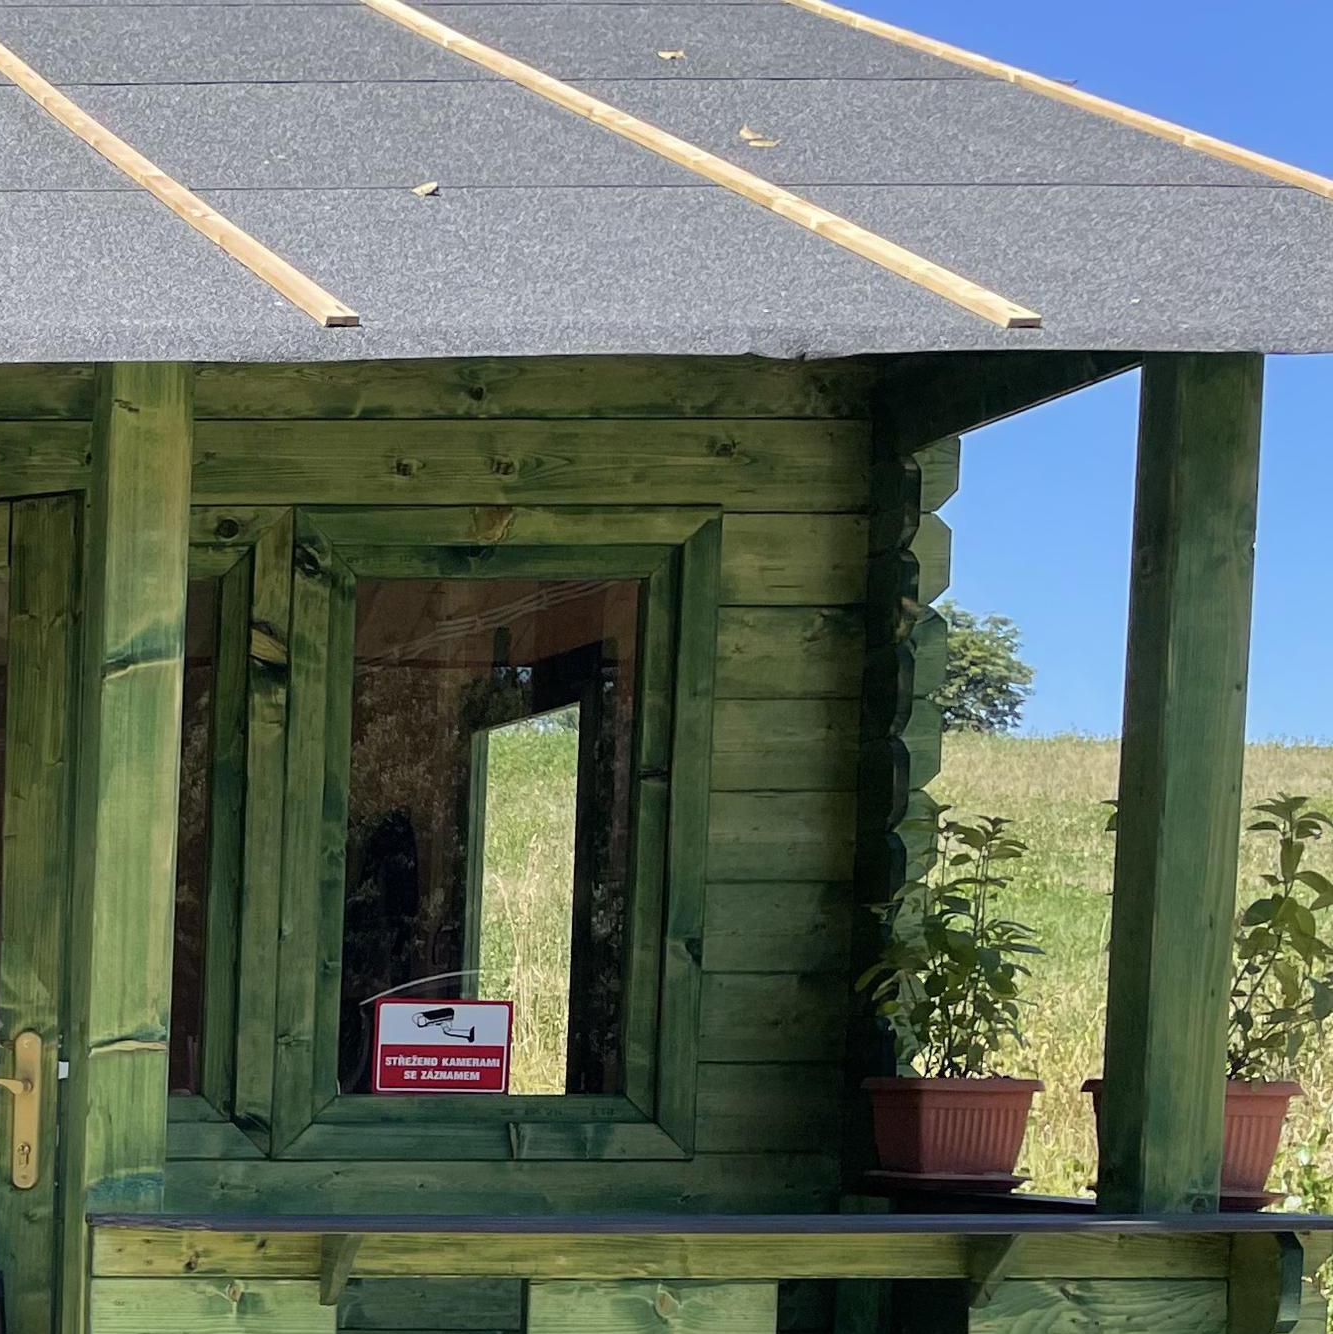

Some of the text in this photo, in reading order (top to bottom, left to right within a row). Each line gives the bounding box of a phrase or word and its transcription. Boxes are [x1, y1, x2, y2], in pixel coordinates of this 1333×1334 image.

[385, 1054, 501, 1068] STŘEŽENO KAMERAMI
[403, 1068, 481, 1081] SE ZÁZNAMEM
